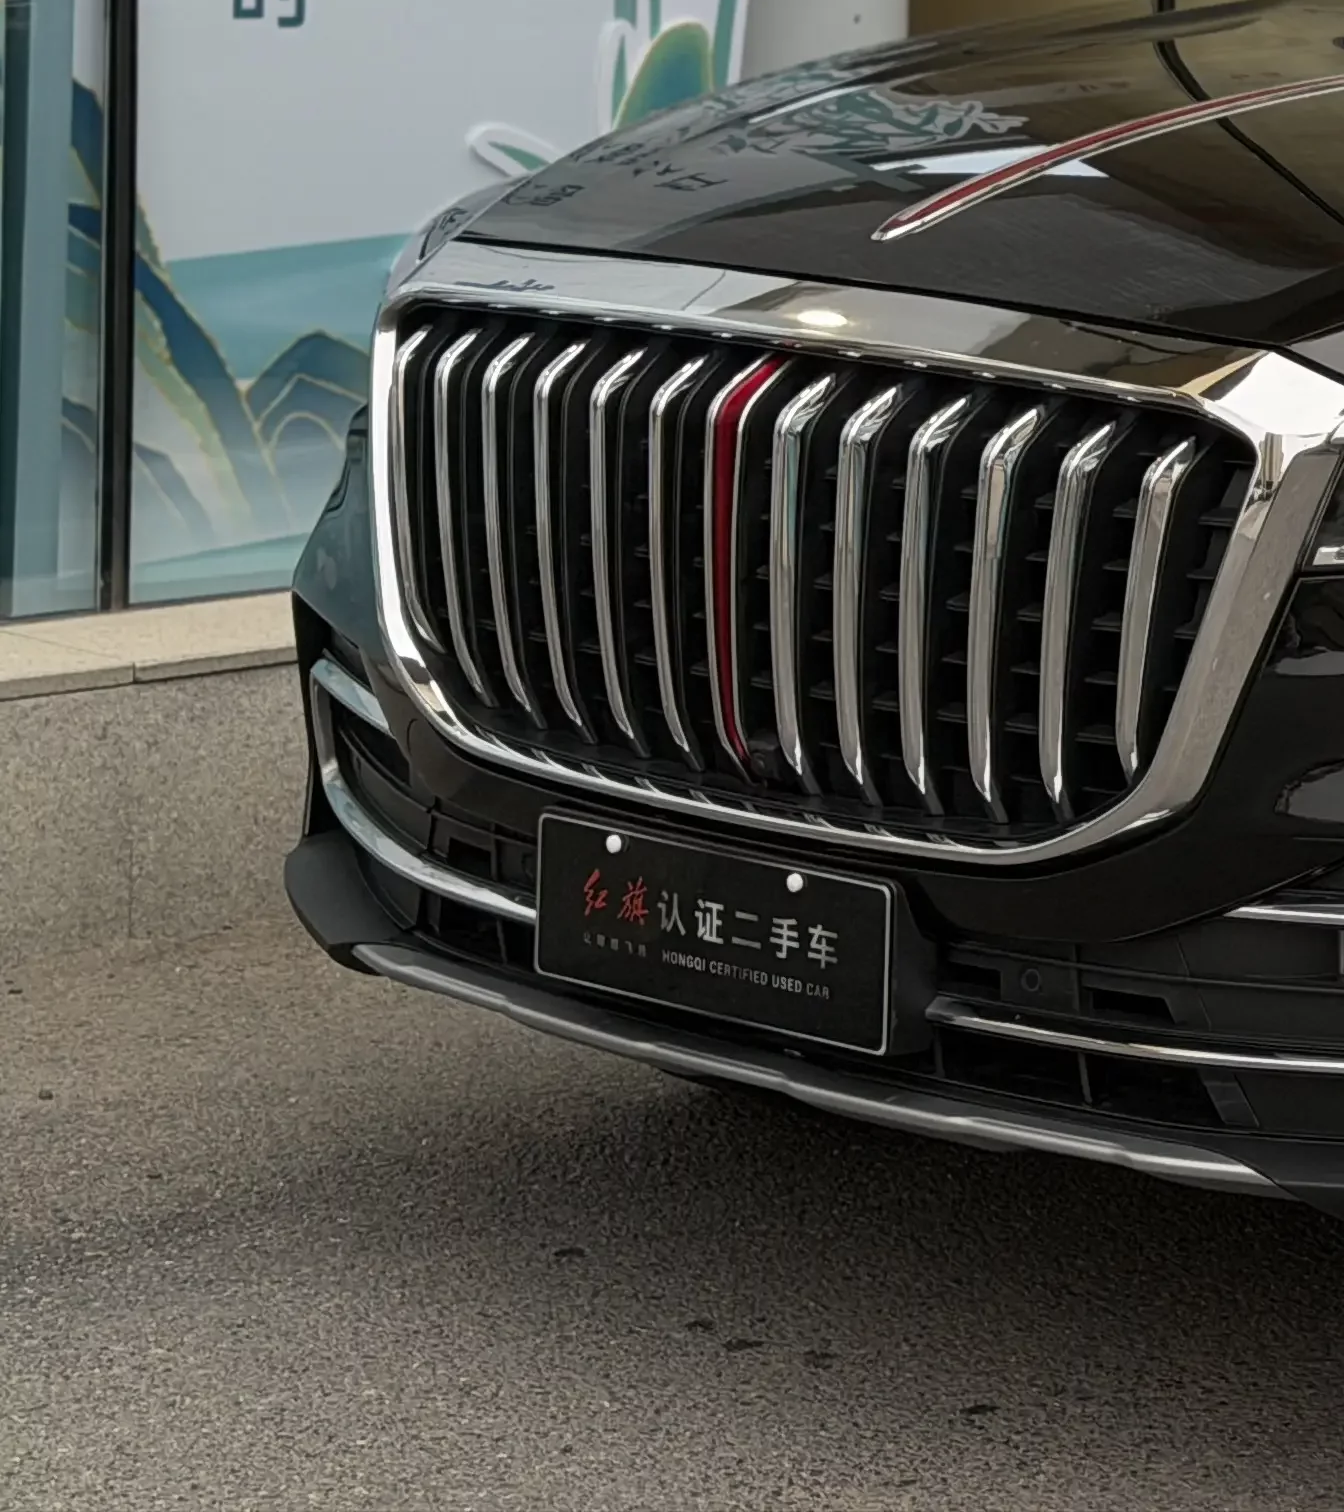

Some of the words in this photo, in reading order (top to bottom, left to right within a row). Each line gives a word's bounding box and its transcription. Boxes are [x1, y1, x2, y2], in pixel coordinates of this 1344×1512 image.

[661, 949, 706, 972] HONGQI
[709, 960, 768, 986] CERTIFIED
[771, 973, 803, 994] USED
[806, 982, 830, 1000] CAR
